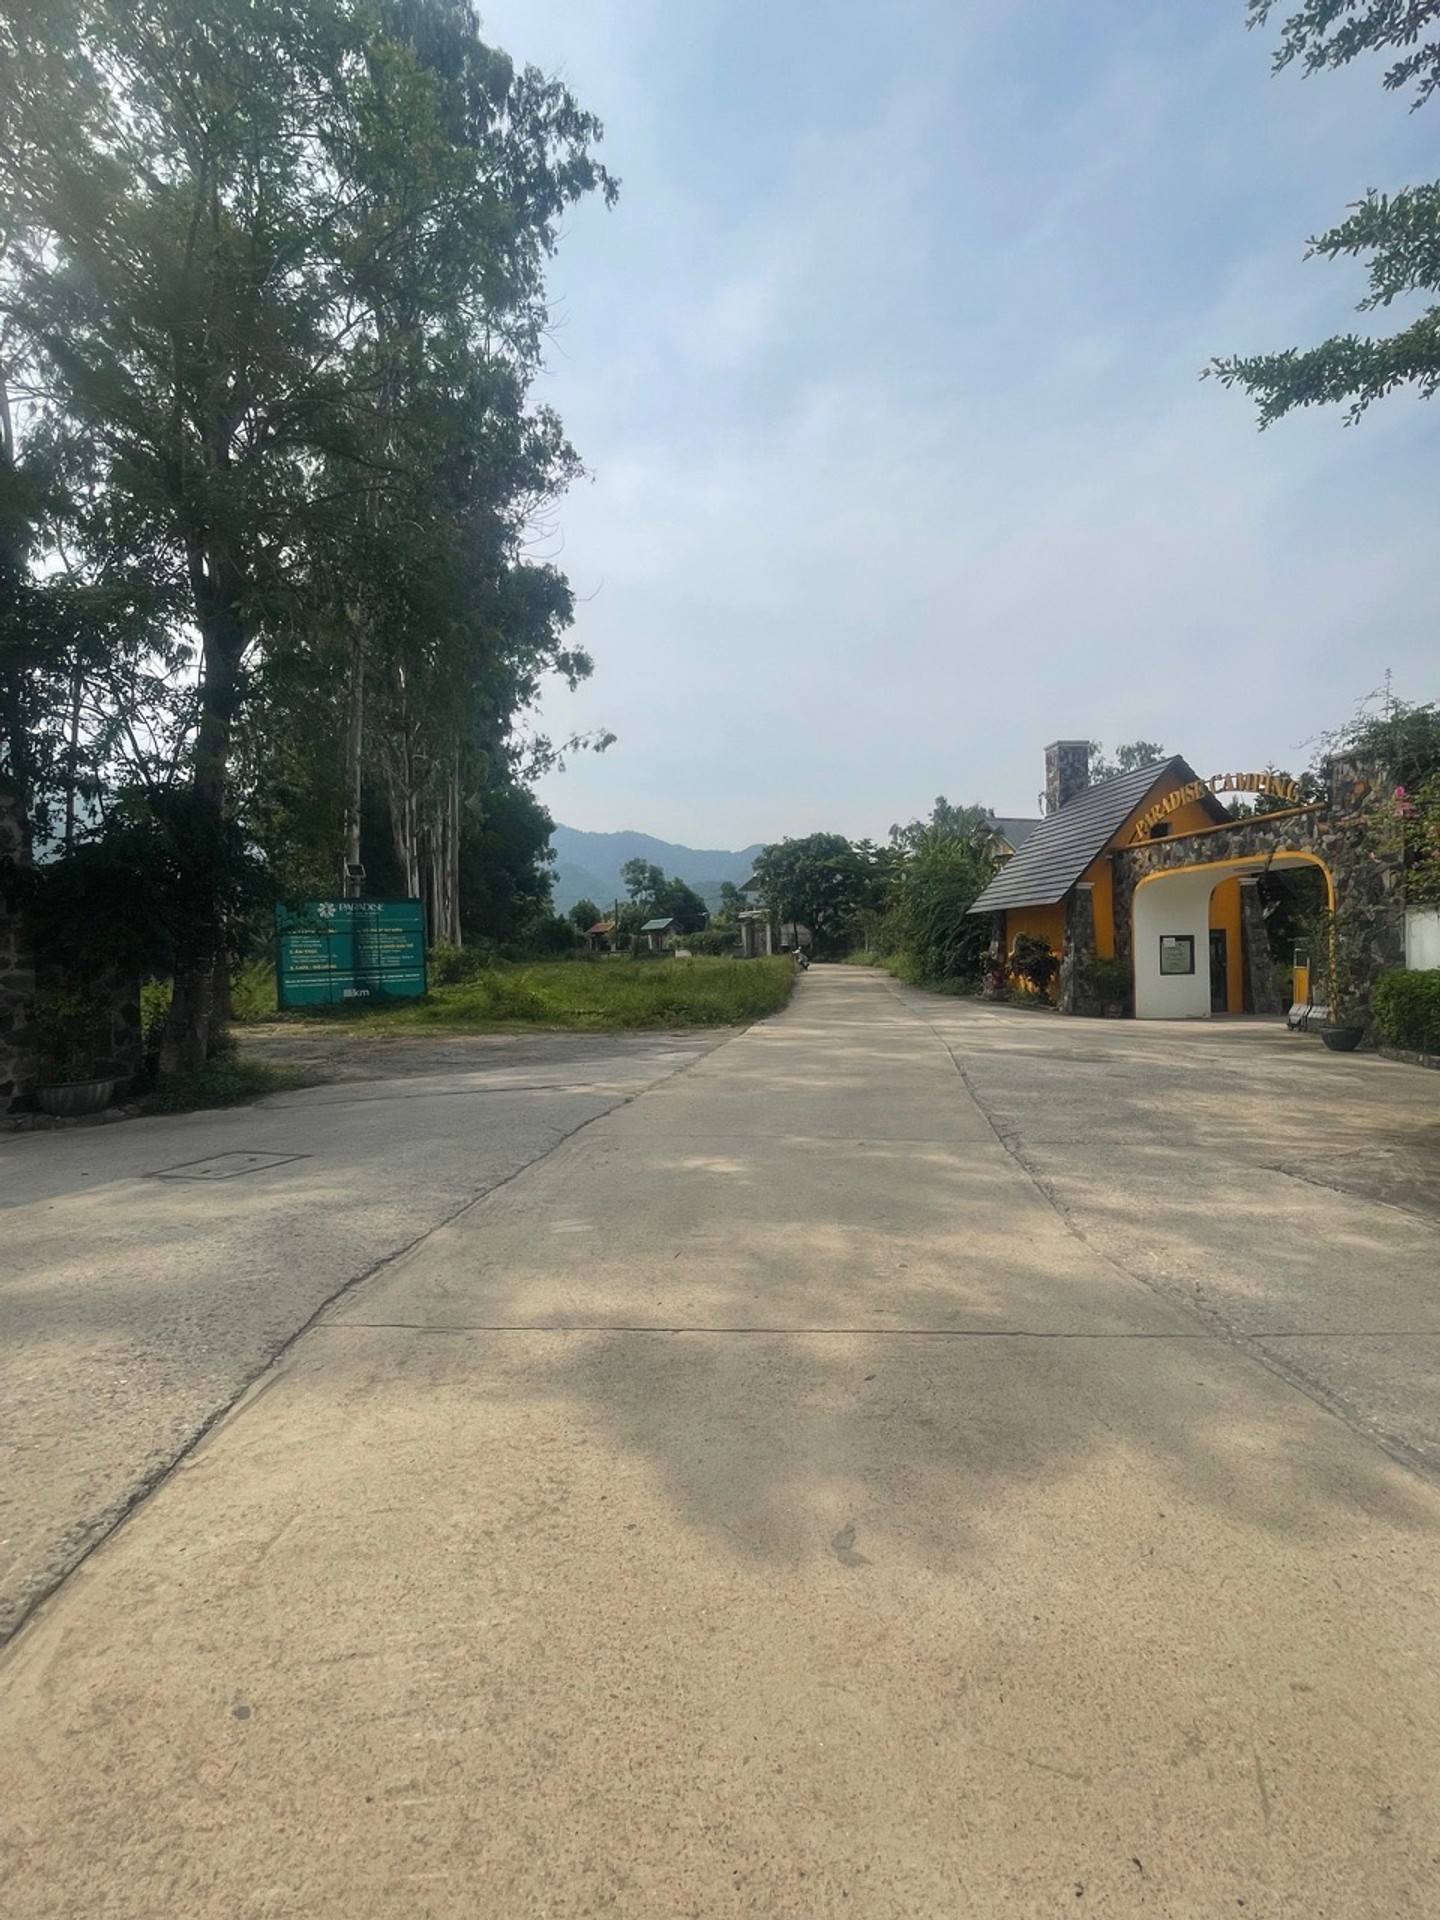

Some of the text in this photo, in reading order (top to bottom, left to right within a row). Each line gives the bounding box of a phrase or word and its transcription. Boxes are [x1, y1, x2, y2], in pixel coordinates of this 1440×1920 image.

[1135, 773, 1299, 837] PARADISE CAMPING
[339, 903, 384, 911] PARADISE
